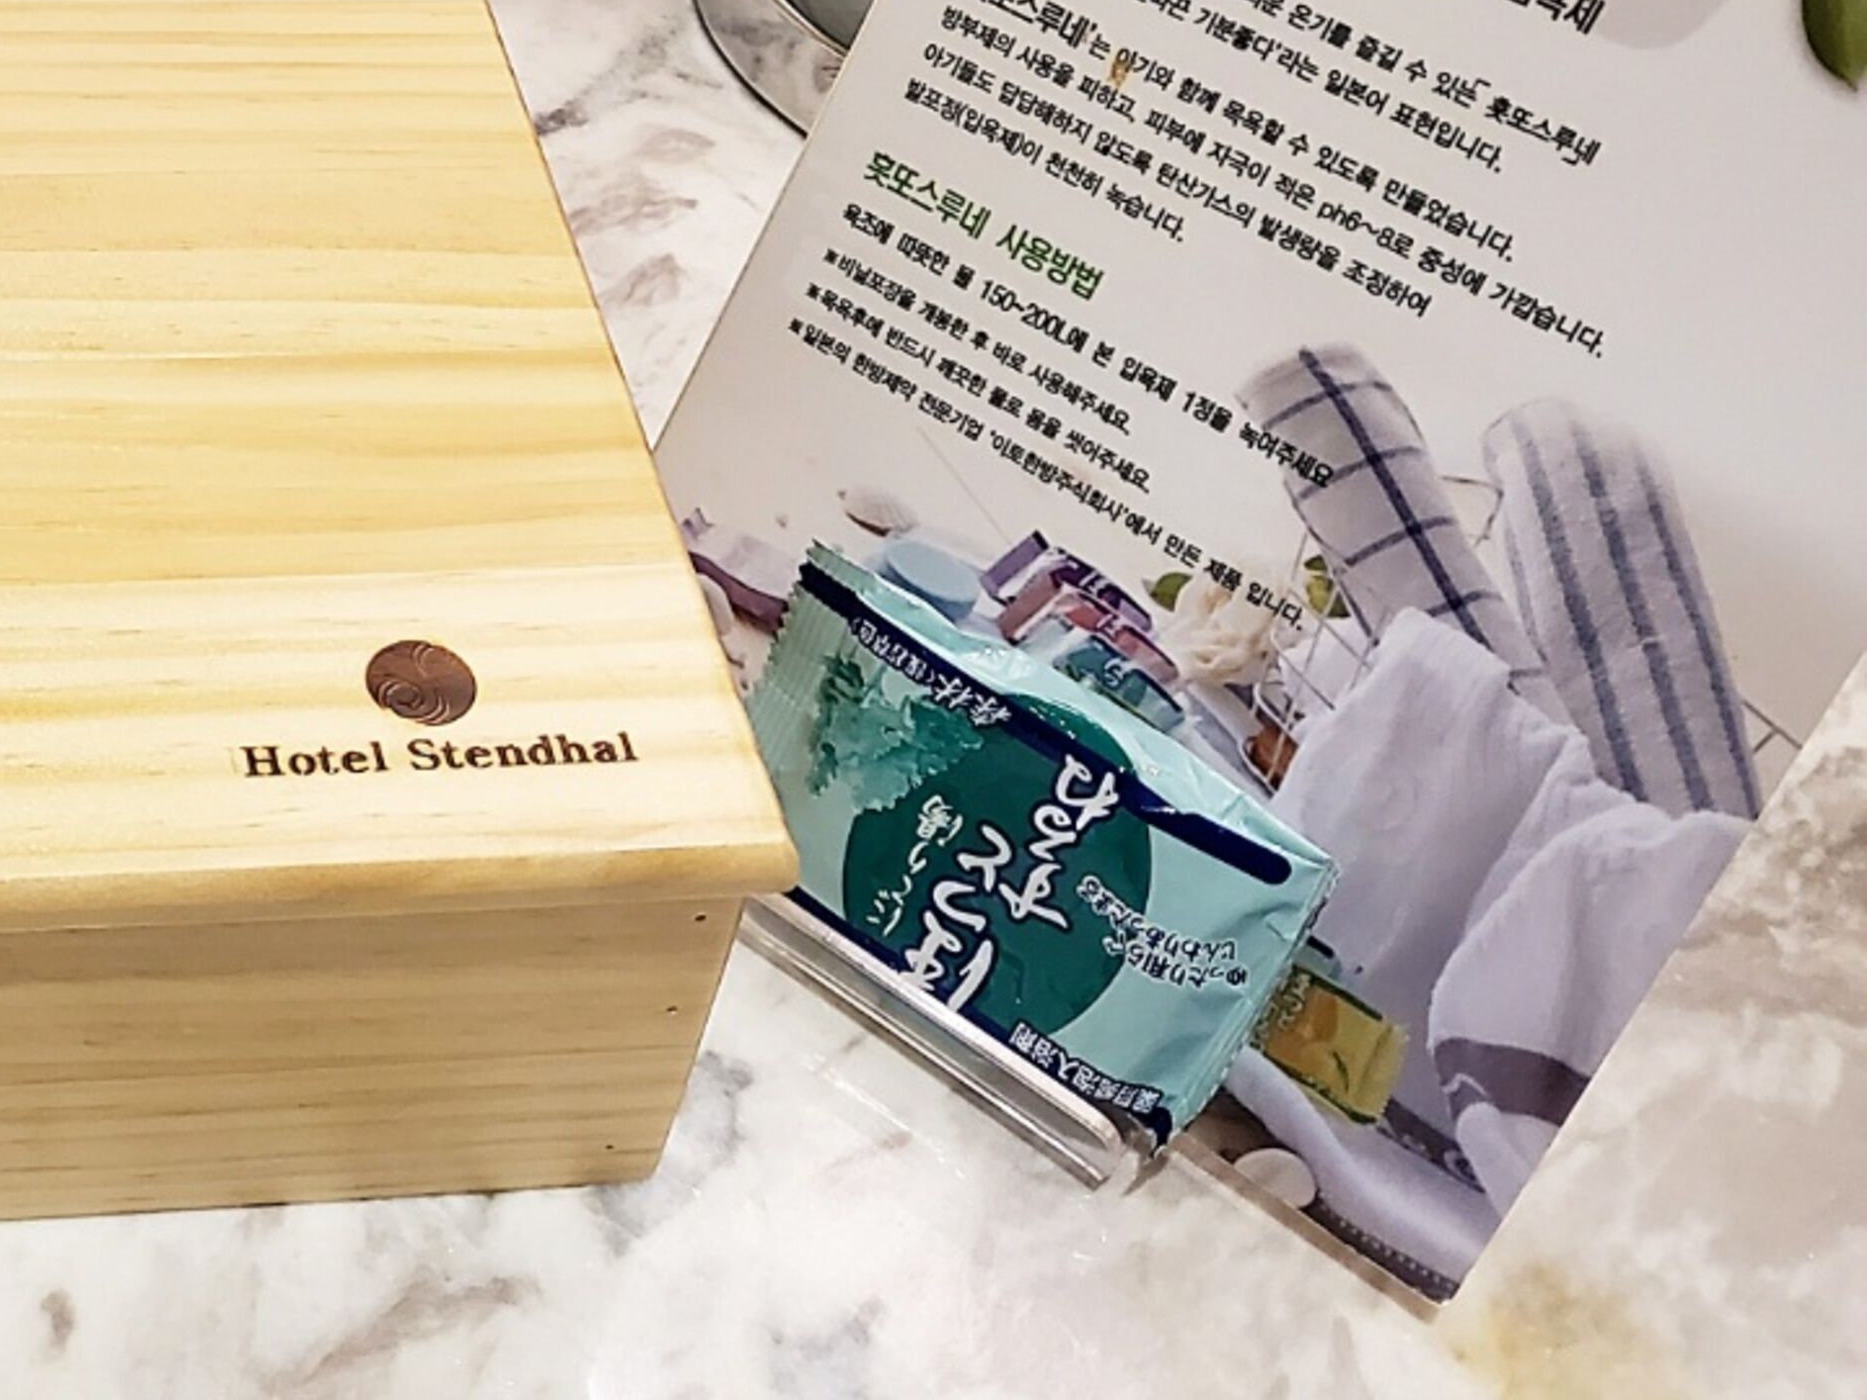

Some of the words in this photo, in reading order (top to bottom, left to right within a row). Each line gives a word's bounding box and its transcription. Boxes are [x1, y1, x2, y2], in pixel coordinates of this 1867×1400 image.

[1286, 2, 1353, 50] 온기를
[1354, 34, 1403, 73] 즐길
[1403, 58, 1427, 83] 수
[922, 42, 996, 94] 아기들도
[997, 80, 1094, 145] 답답해하지
[1092, 130, 1153, 175] 않도록
[1155, 161, 1257, 229] 탄산가스의
[1256, 213, 1341, 272] 발생량을
[940, 4, 1017, 58] 방부제의
[1014, 45, 1075, 88] 사용을
[1143, 108, 1207, 155] 피부에
[1273, 172, 1316, 211] 적은
[1111, 47, 1176, 91] 아기와
[1175, 76, 1222, 114] 함께
[1221, 98, 1285, 145] 목욕할
[1287, 133, 1309, 156] 수
[1313, 144, 1380, 191] 있도록
[1381, 177, 1513, 260] 만들었습니다.
[1323, 68, 1390, 116] 일본어
[1388, 101, 1502, 174] 표현입니다.
[862, 150, 992, 240] 홋또스루네
[994, 223, 1104, 301] 사용방법
[1044, 151, 1104, 198] 천천히
[1105, 182, 1184, 243] 녹습니다.
[842, 202, 895, 245] 욕조에
[895, 232, 950, 276] 따뜻한
[951, 263, 975, 290] 물
[1090, 340, 1115, 368] 본
[1118, 356, 1178, 402] 입욕제
[1181, 391, 1233, 433] 1정을
[883, 325, 937, 368] 반드시
[916, 300, 969, 341] 개봉한
[969, 329, 990, 350] 후
[991, 341, 1027, 374] 바로
[917, 390, 985, 441] 전문기업
[1162, 533, 1202, 568] 만든
[1202, 557, 1243, 597] 제품
[241, 742, 390, 778] Hotel
[406, 731, 640, 772] Stendhal
